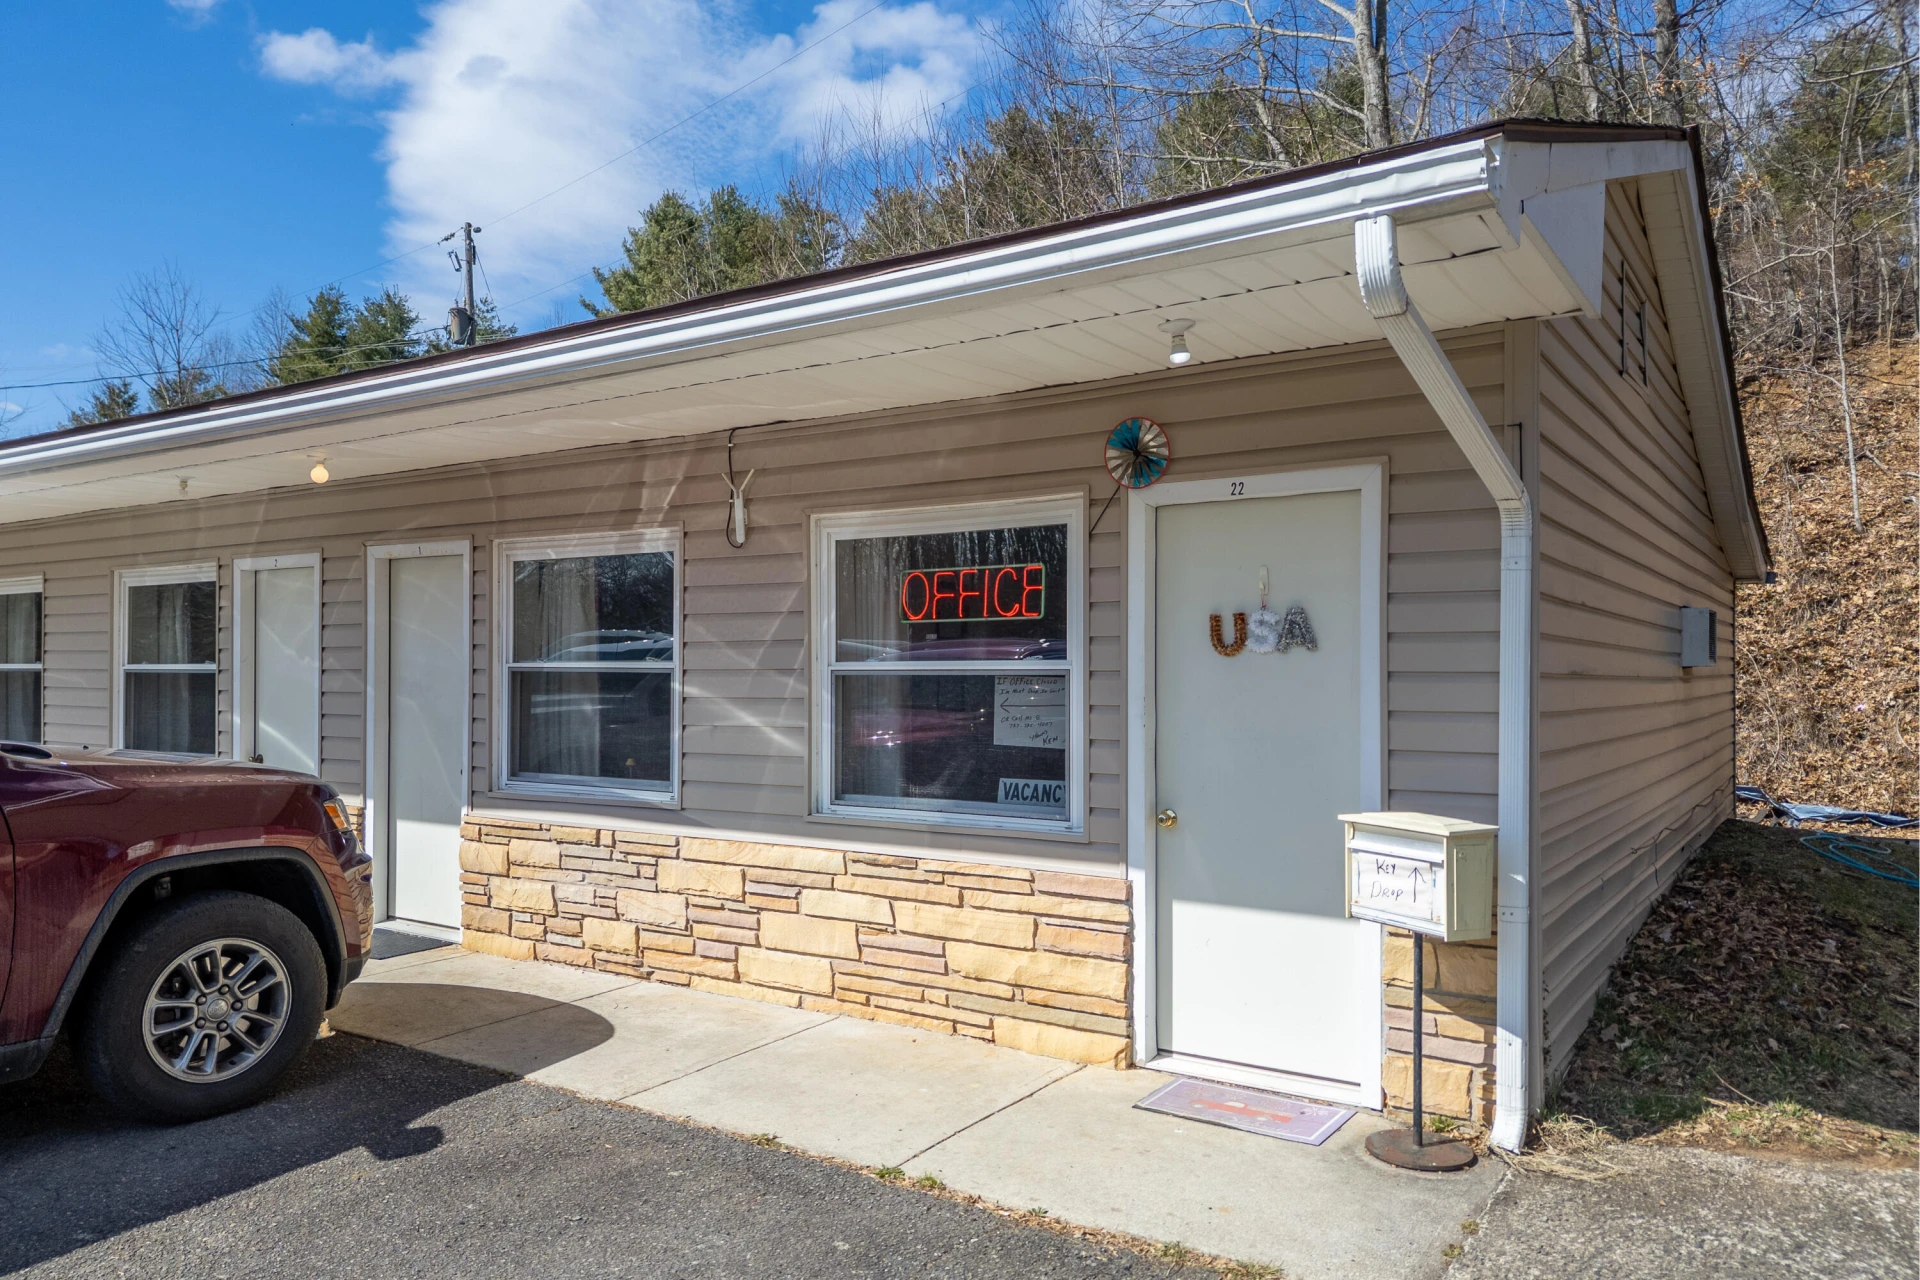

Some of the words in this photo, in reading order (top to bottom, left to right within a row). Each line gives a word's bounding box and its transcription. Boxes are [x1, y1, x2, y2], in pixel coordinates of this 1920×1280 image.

[1230, 481, 1245, 496] 22
[902, 564, 1043, 621] OFFICE
[1209, 604, 1318, 657] USA
